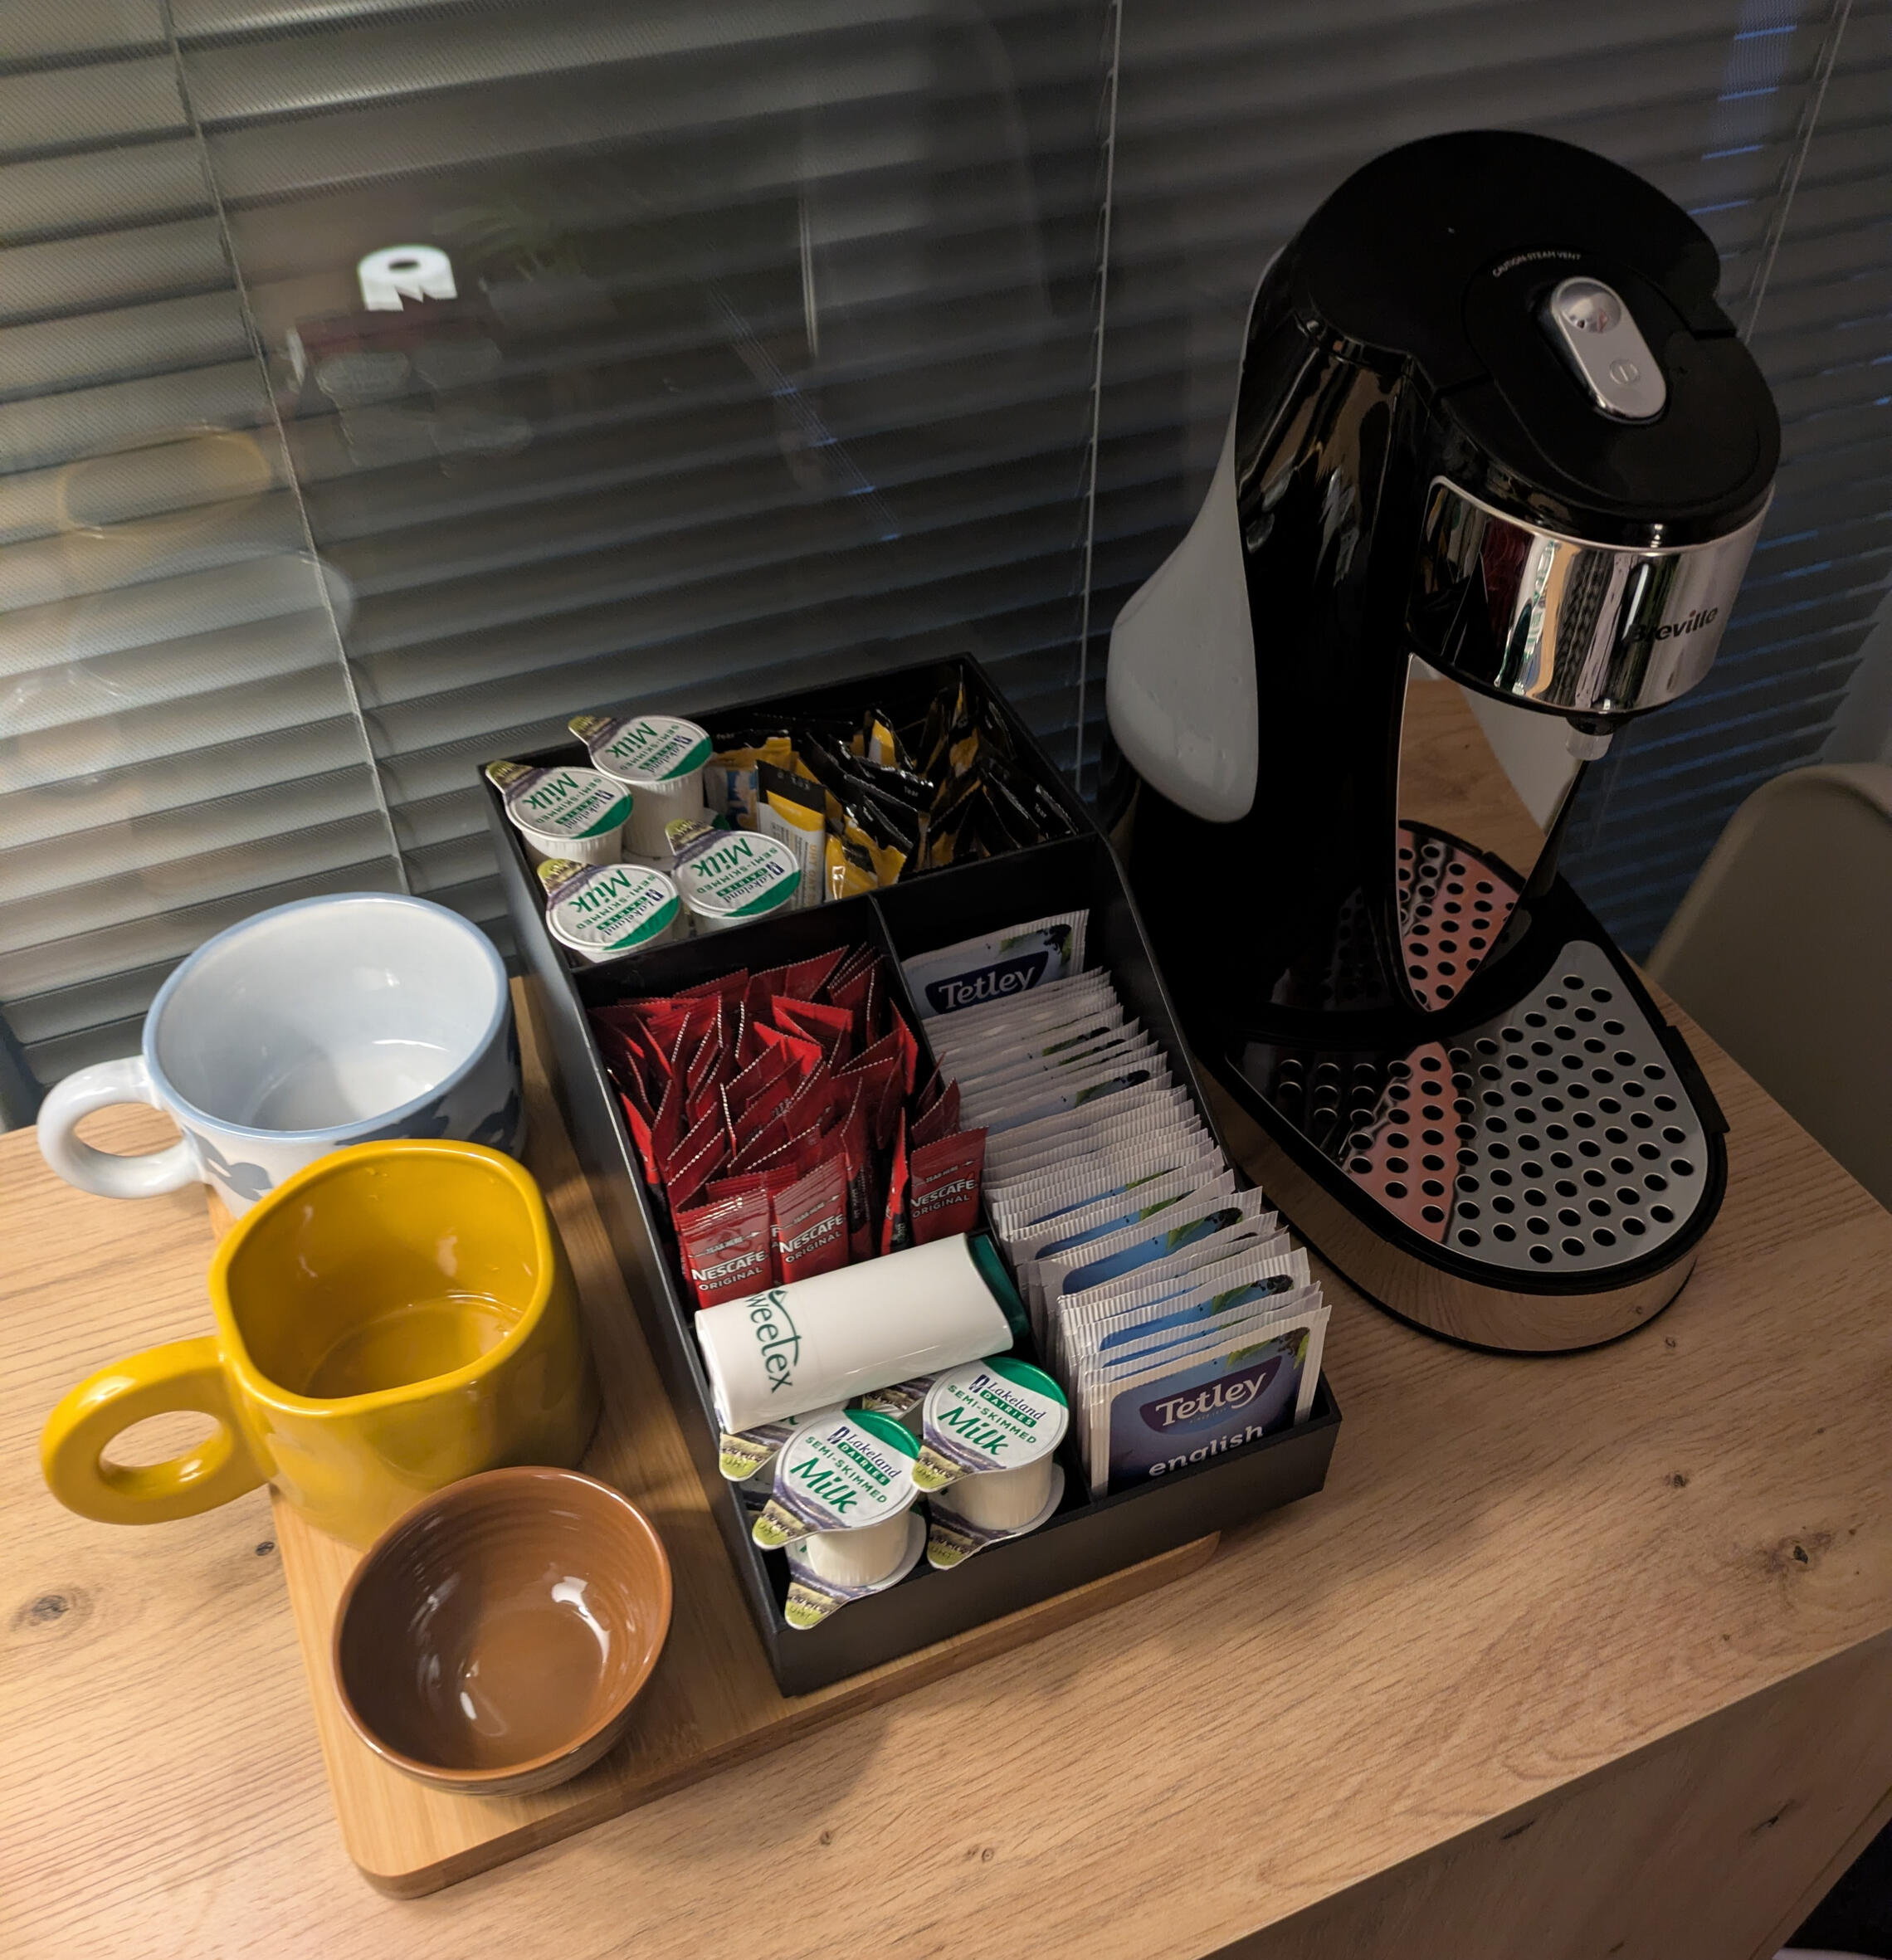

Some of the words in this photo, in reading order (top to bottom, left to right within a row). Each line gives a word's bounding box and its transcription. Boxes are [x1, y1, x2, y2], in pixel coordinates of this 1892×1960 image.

[1626, 607, 1718, 643] Breville
[605, 722, 658, 758] Milk
[522, 773, 579, 810] Milk
[690, 837, 753, 878] Milk
[697, 846, 778, 895] SEMI-SKIMMED
[568, 869, 631, 913] Milk
[577, 874, 657, 929] SEMI-SKIMMED
[722, 873, 774, 904] Lakeland
[602, 899, 656, 936] Lakeland
[939, 967, 1036, 1010] Tetley
[913, 1195, 970, 1218] ORIGINAL
[785, 1231, 842, 1263] ORIGINAL
[699, 1266, 763, 1291] ORIGINAL
[745, 1290, 802, 1393] weetex
[948, 1384, 1037, 1444] SEMI-SKIMMED
[982, 1392, 1034, 1426] DAIRIES
[987, 1382, 1047, 1421] Lakeland
[1156, 1372, 1266, 1426] Tetley
[937, 1406, 1009, 1455] Milk
[1149, 1426, 1264, 1477] english
[805, 1436, 888, 1504] SEMI-SKIMMED
[840, 1443, 888, 1484] DAIRIES
[846, 1433, 902, 1479] Lakeland
[790, 1457, 858, 1514] Milk
